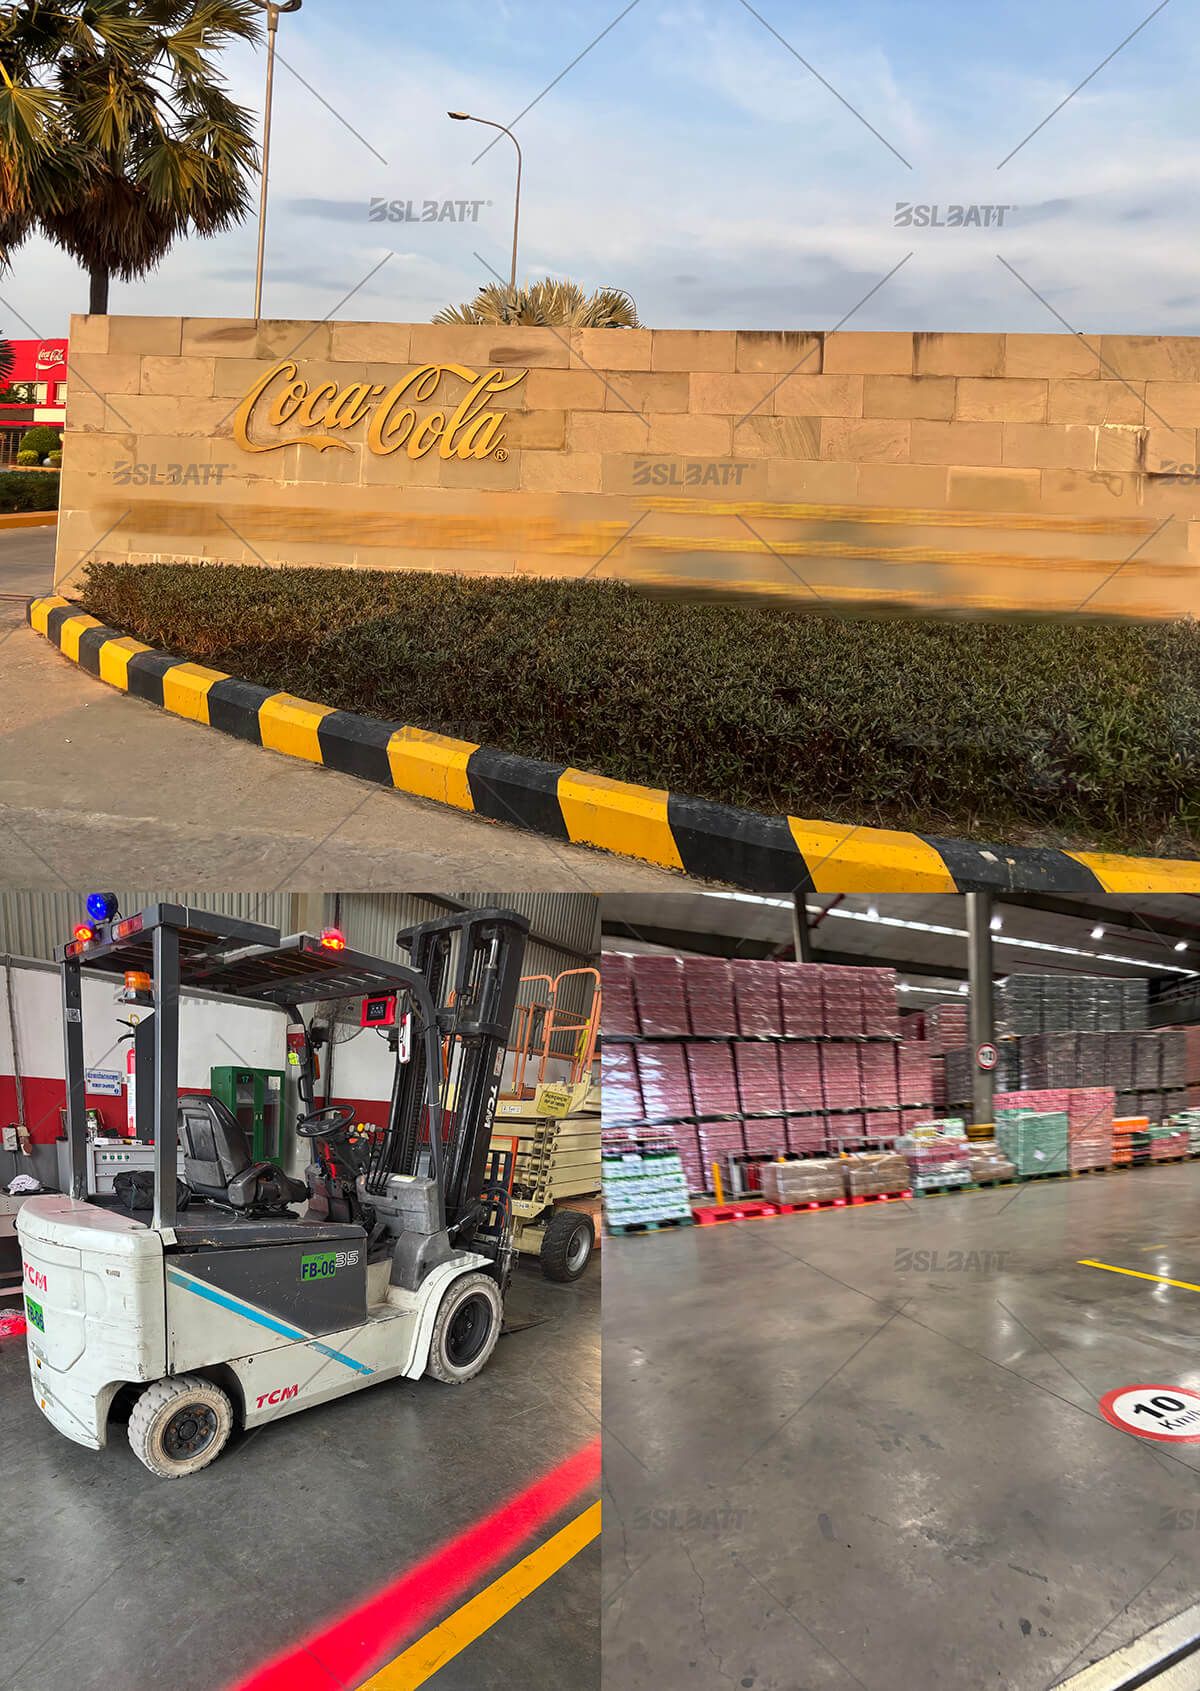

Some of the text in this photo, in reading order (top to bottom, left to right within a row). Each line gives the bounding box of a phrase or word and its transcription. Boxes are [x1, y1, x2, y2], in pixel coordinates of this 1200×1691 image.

[483, 1085, 498, 1129] TCM
[24, 1262, 48, 1292] TCM
[302, 1260, 335, 1279] FB-06
[256, 1384, 298, 1409] TCM
[1133, 1396, 1186, 1418] 10
